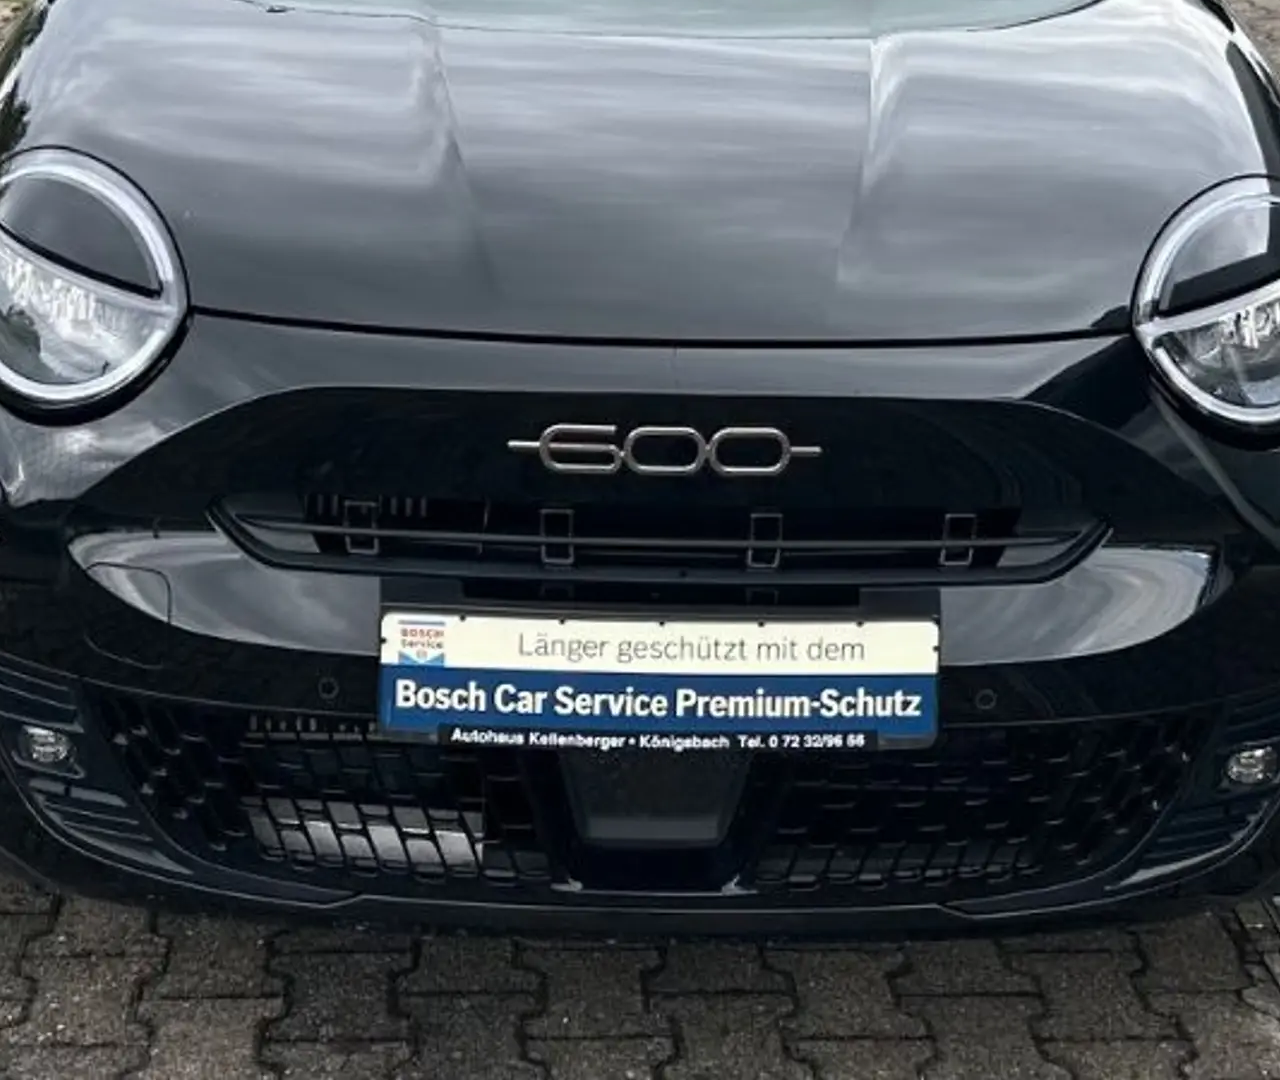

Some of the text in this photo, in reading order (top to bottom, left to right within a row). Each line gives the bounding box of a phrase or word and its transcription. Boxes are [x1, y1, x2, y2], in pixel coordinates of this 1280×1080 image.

[539, 423, 792, 476] 600
[518, 632, 865, 663] Länger geschützt mit dem
[395, 679, 922, 718] Bosch Car Service Premium-Schutz
[451, 727, 524, 745] Autohaus
[639, 734, 730, 752] Königsbach
[737, 735, 765, 749] Tel.
